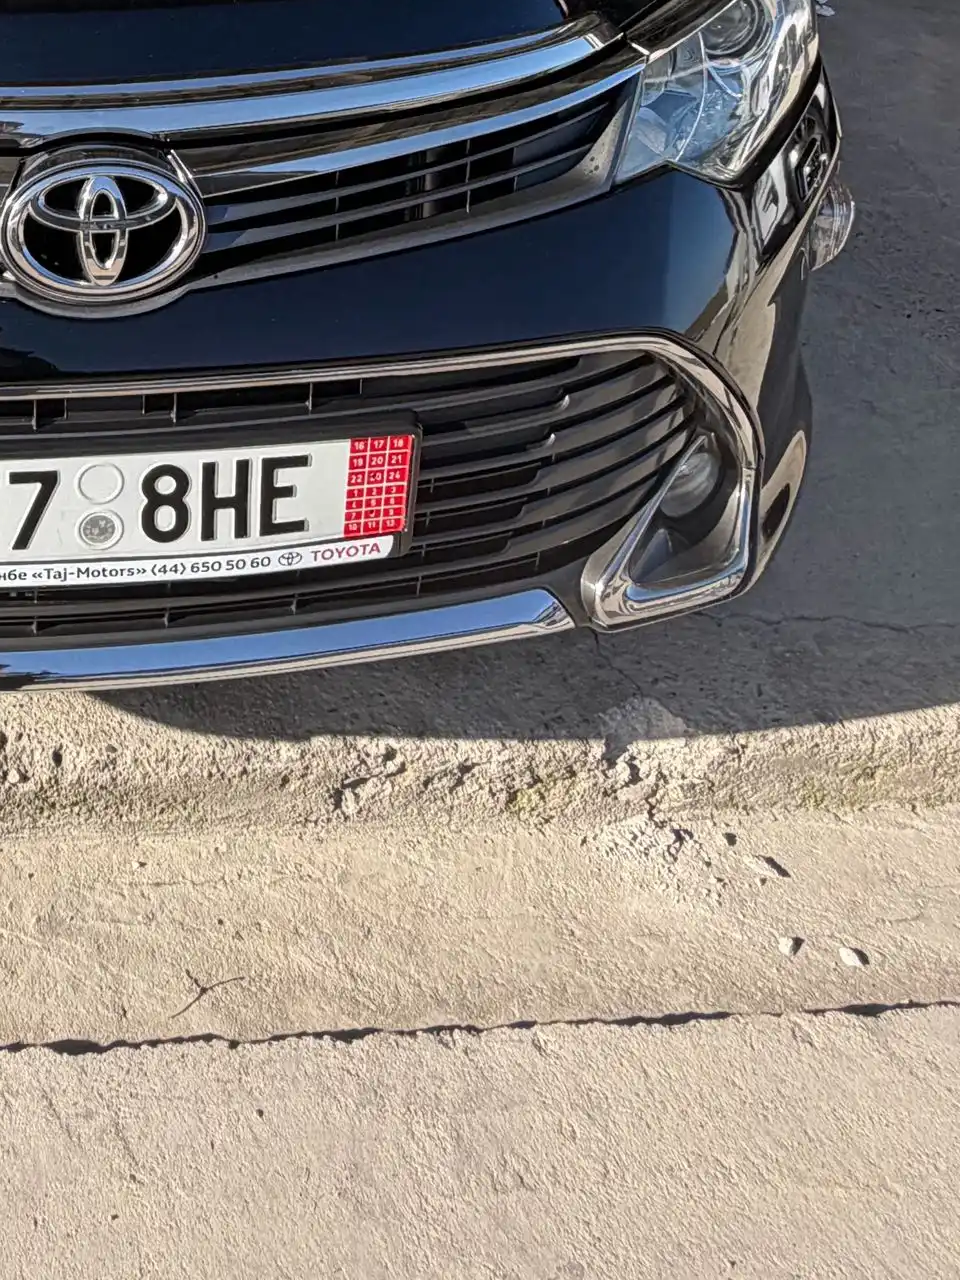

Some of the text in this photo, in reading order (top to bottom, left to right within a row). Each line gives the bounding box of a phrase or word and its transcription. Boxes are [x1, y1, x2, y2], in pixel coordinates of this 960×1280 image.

[354, 441, 364, 450] 16
[373, 439, 384, 449] 17
[371, 456, 383, 465] 20
[391, 455, 402, 464] 21
[350, 474, 362, 483] 22
[32, 566, 147, 581] «Taj-Motors»
[150, 564, 187, 577] (44)
[190, 561, 222, 574] 650
[225, 559, 245, 571] 50
[250, 557, 271, 569] 60
[310, 542, 381, 562] TOYOTA
